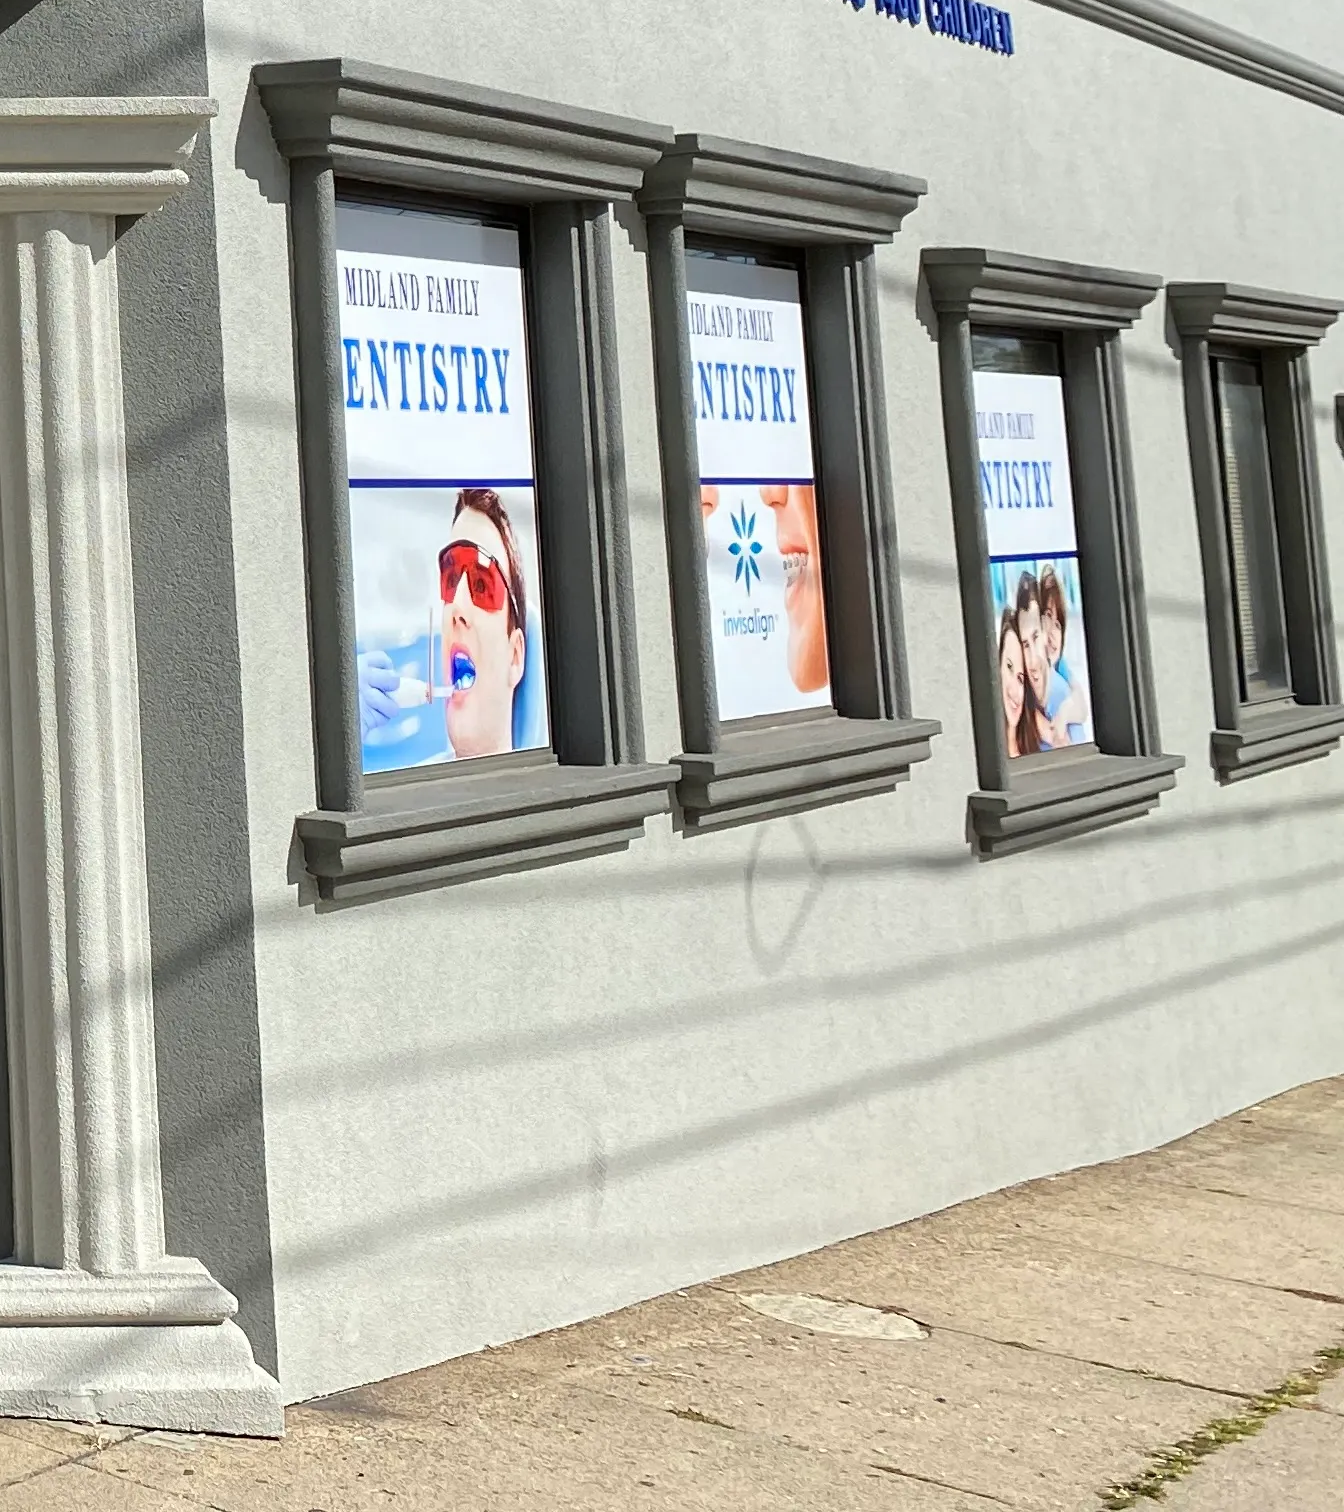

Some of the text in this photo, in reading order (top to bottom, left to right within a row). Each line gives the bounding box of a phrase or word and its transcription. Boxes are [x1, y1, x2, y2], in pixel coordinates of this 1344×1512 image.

[344, 266, 480, 317] MIDLAND FAMILY
[688, 303, 774, 342] IDLAND FAMILY
[343, 338, 510, 415] ENTISTRY
[695, 361, 796, 423] NTISTRY
[980, 461, 1053, 508] NTISTRY
